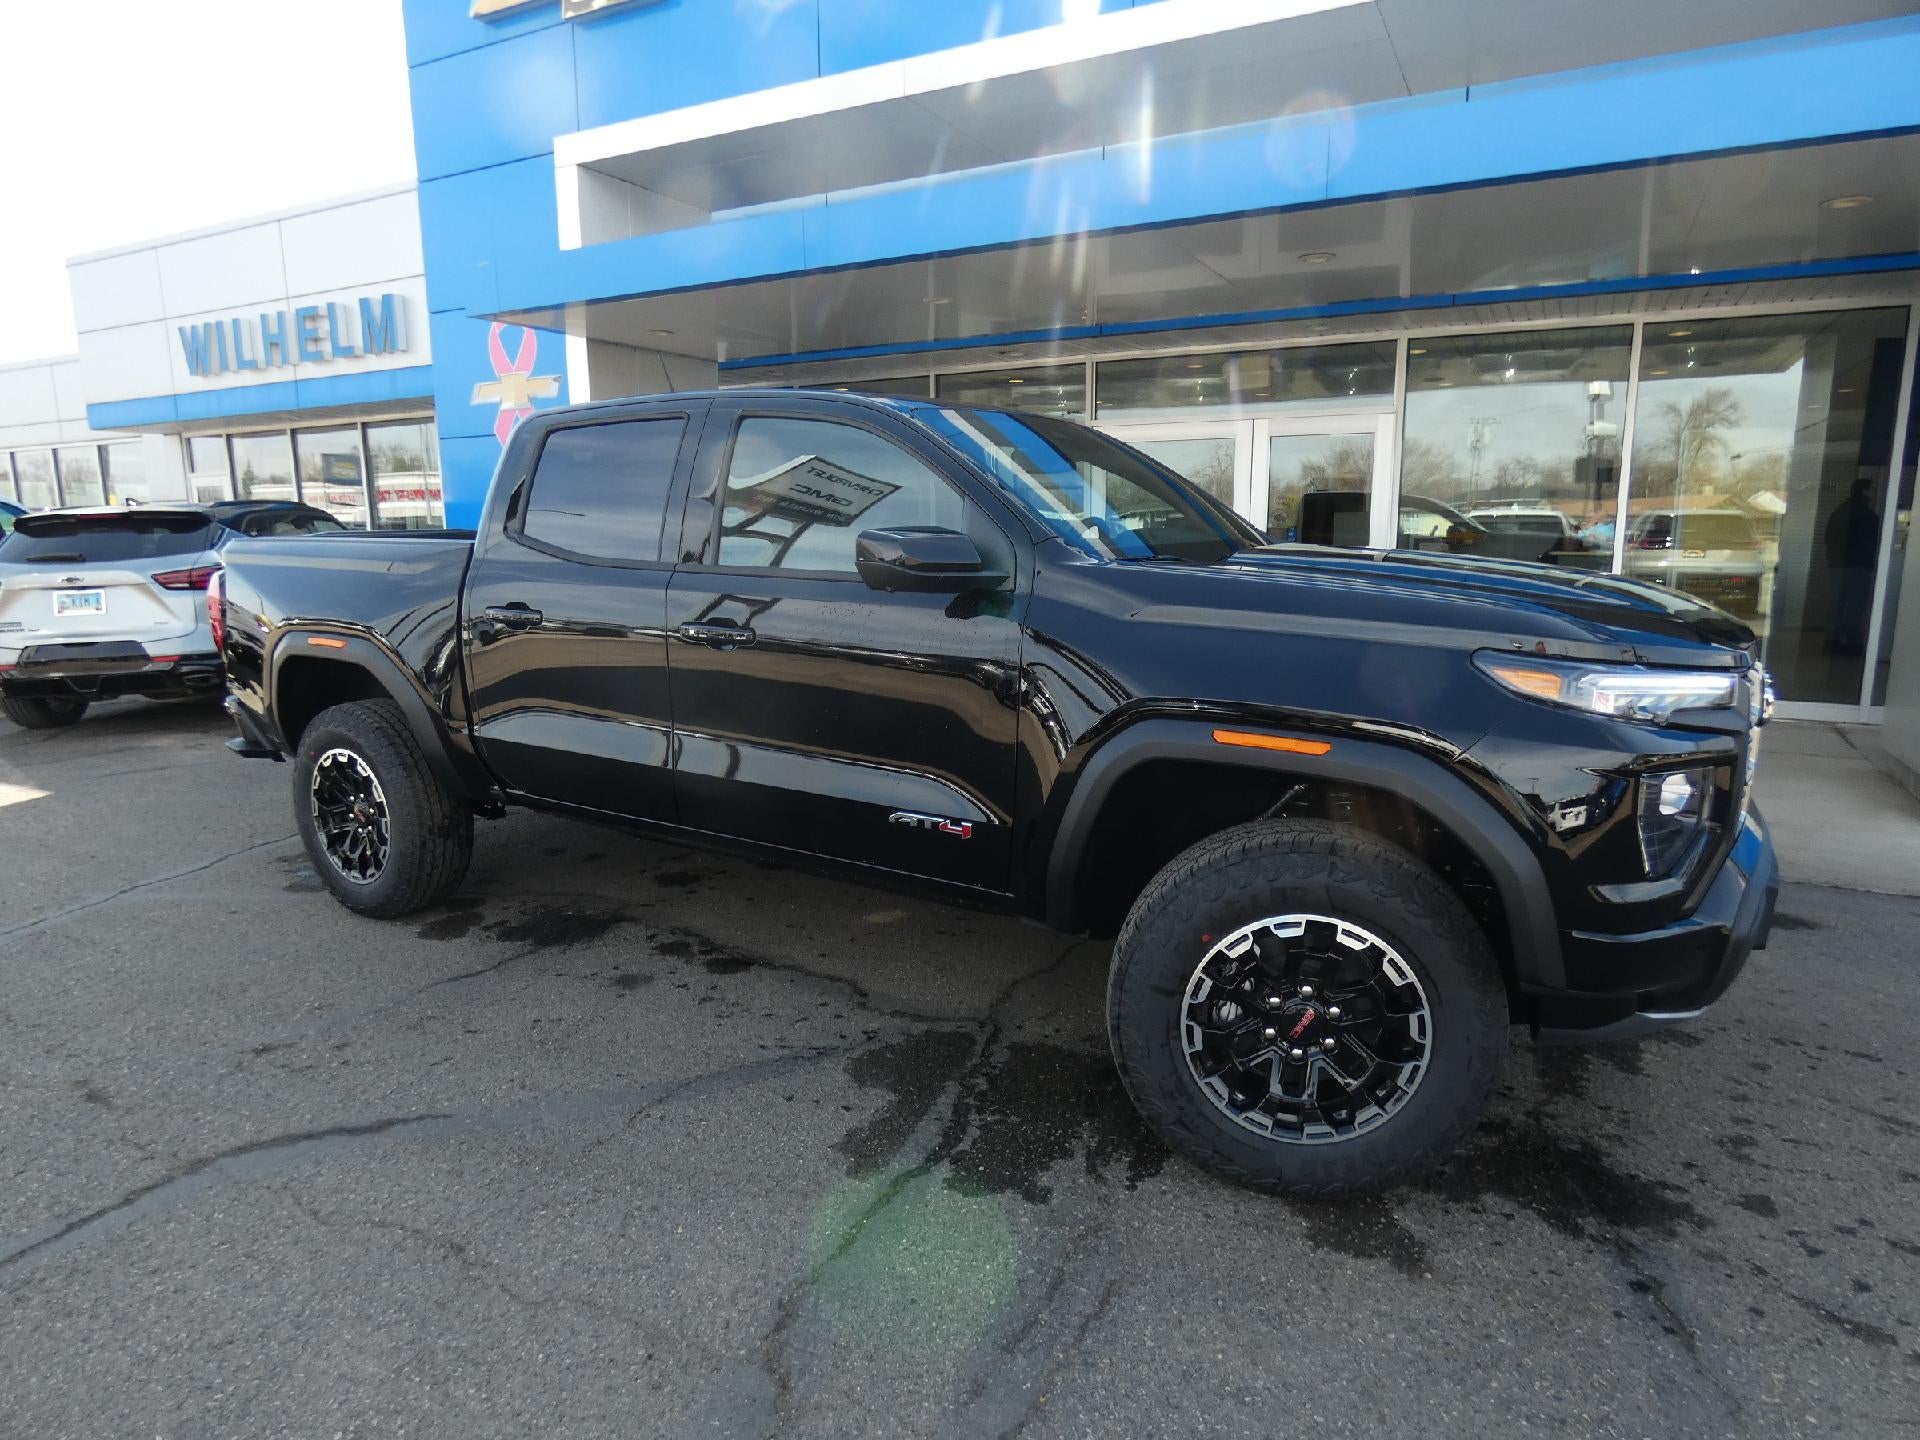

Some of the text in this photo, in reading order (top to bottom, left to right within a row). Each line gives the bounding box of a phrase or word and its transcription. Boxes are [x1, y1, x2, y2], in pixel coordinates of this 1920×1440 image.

[178, 293, 408, 377] WILHELM
[888, 811, 973, 840] AT4
[1289, 1007, 1315, 1039] GMC
